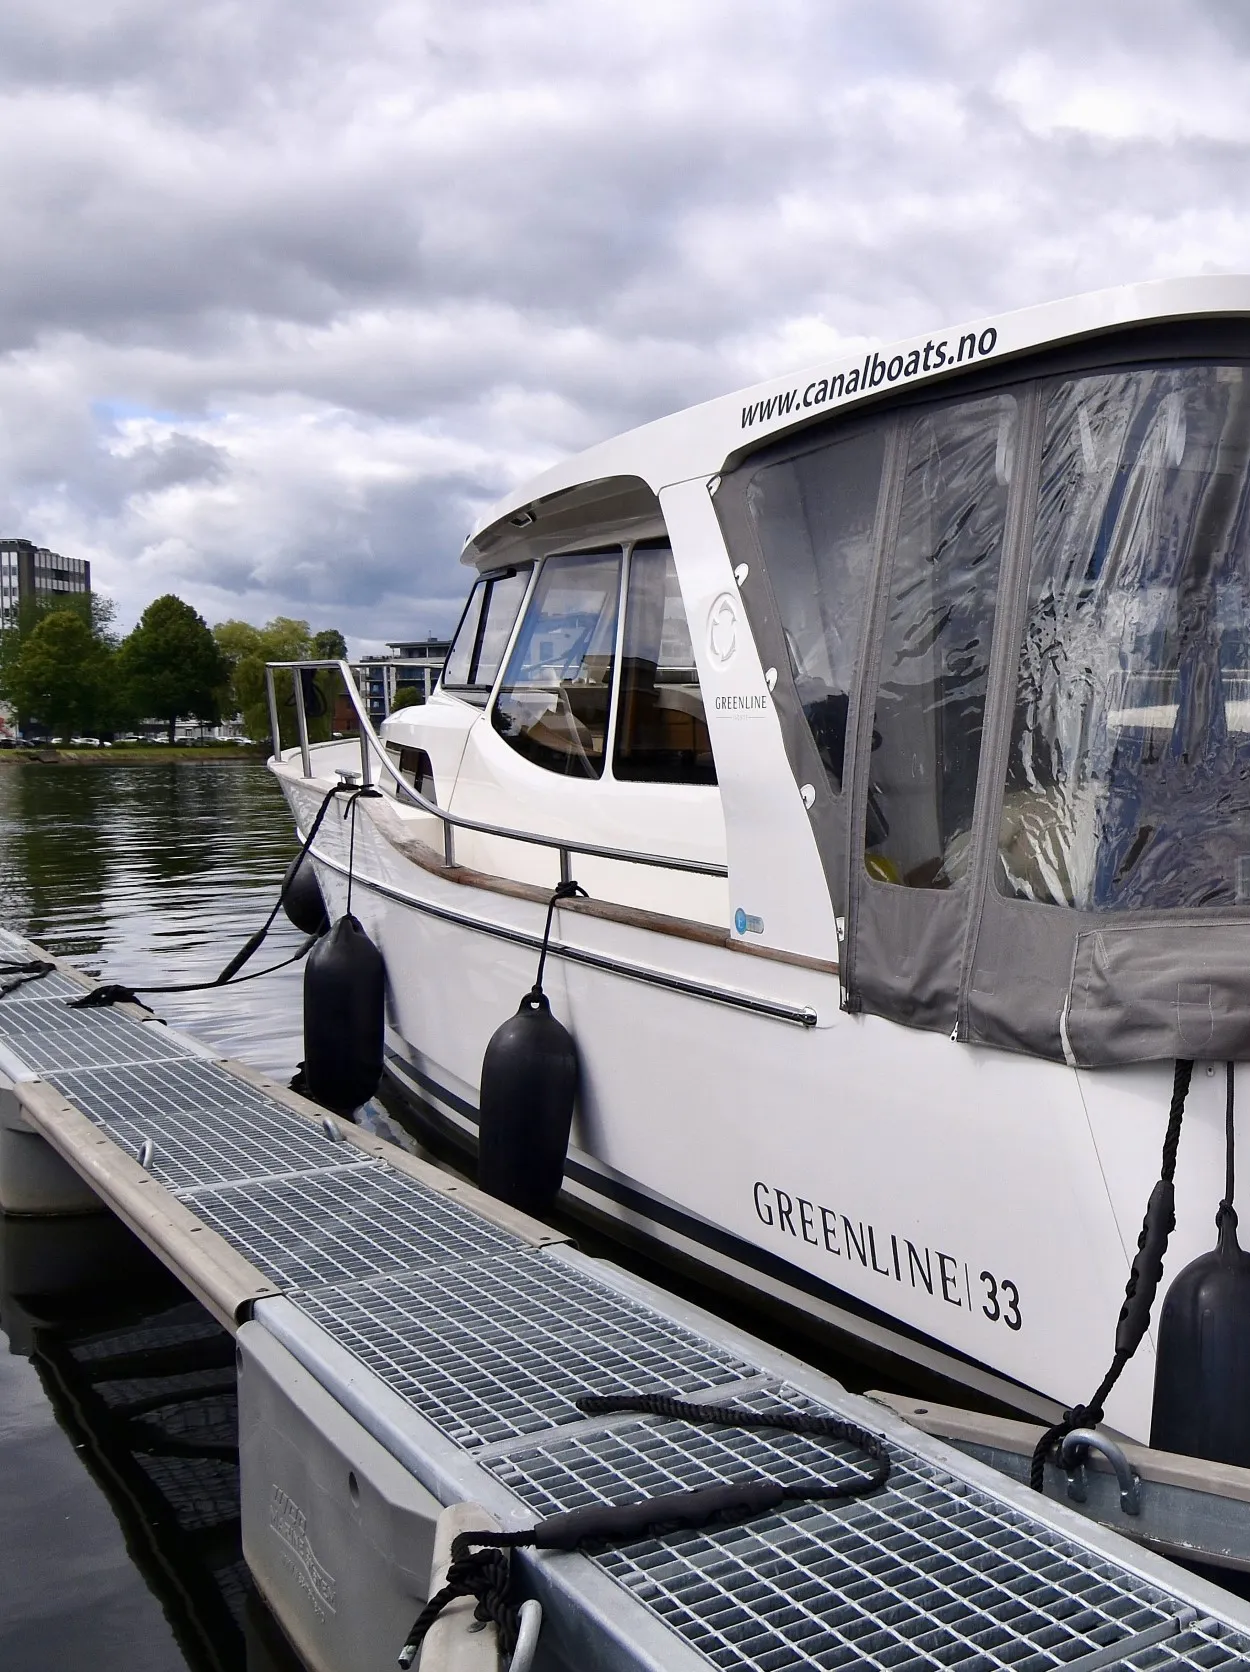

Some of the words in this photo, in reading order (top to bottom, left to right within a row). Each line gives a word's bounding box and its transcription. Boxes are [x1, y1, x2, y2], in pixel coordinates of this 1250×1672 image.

[740, 327, 998, 429] www.canalboats.no
[715, 695, 767, 710] GREENLINE
[753, 1181, 962, 1307] GREENLINE
[979, 1270, 1023, 1332] 33
